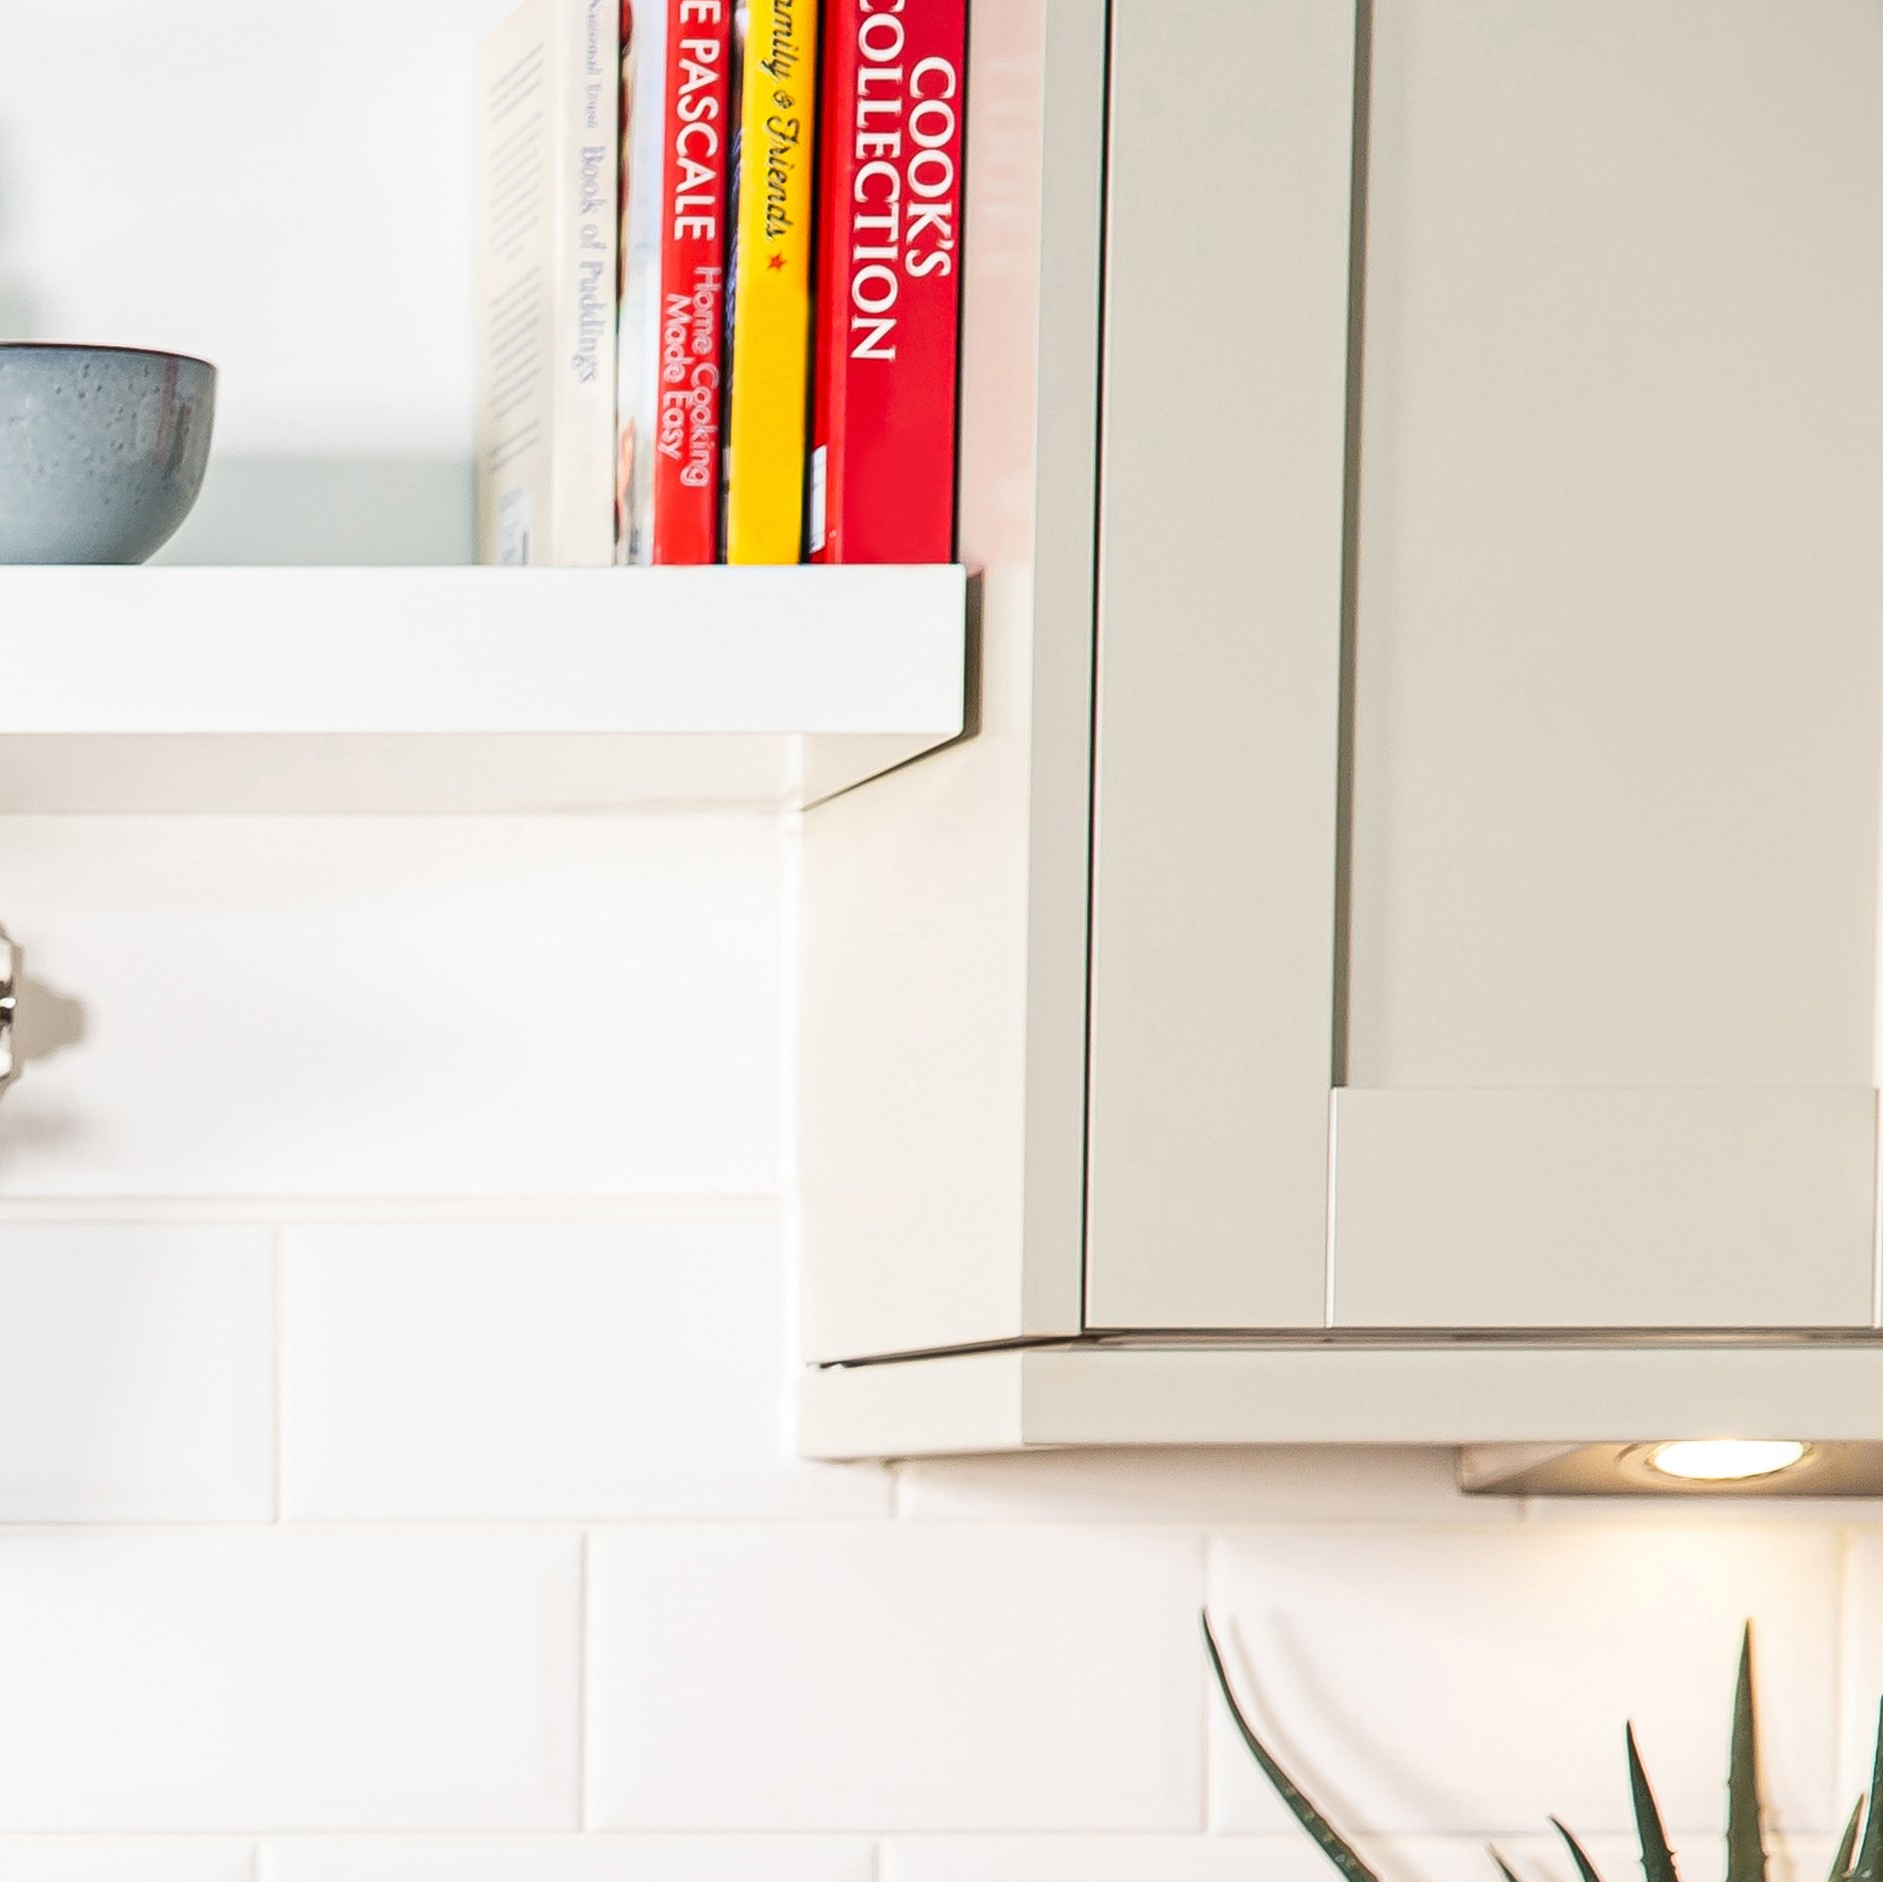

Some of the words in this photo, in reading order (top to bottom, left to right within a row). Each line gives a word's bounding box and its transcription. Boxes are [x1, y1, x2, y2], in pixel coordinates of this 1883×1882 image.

[578, 146, 606, 216] Book
[673, 38, 721, 242] PASCALE
[764, 115, 800, 241] Friends
[905, 56, 957, 278] COOK'S
[579, 223, 607, 249] of
[572, 260, 607, 384] Puddings
[663, 293, 695, 384] Made
[692, 266, 722, 355] Home
[657, 390, 694, 460] Easy
[680, 362, 720, 487] Cooking
